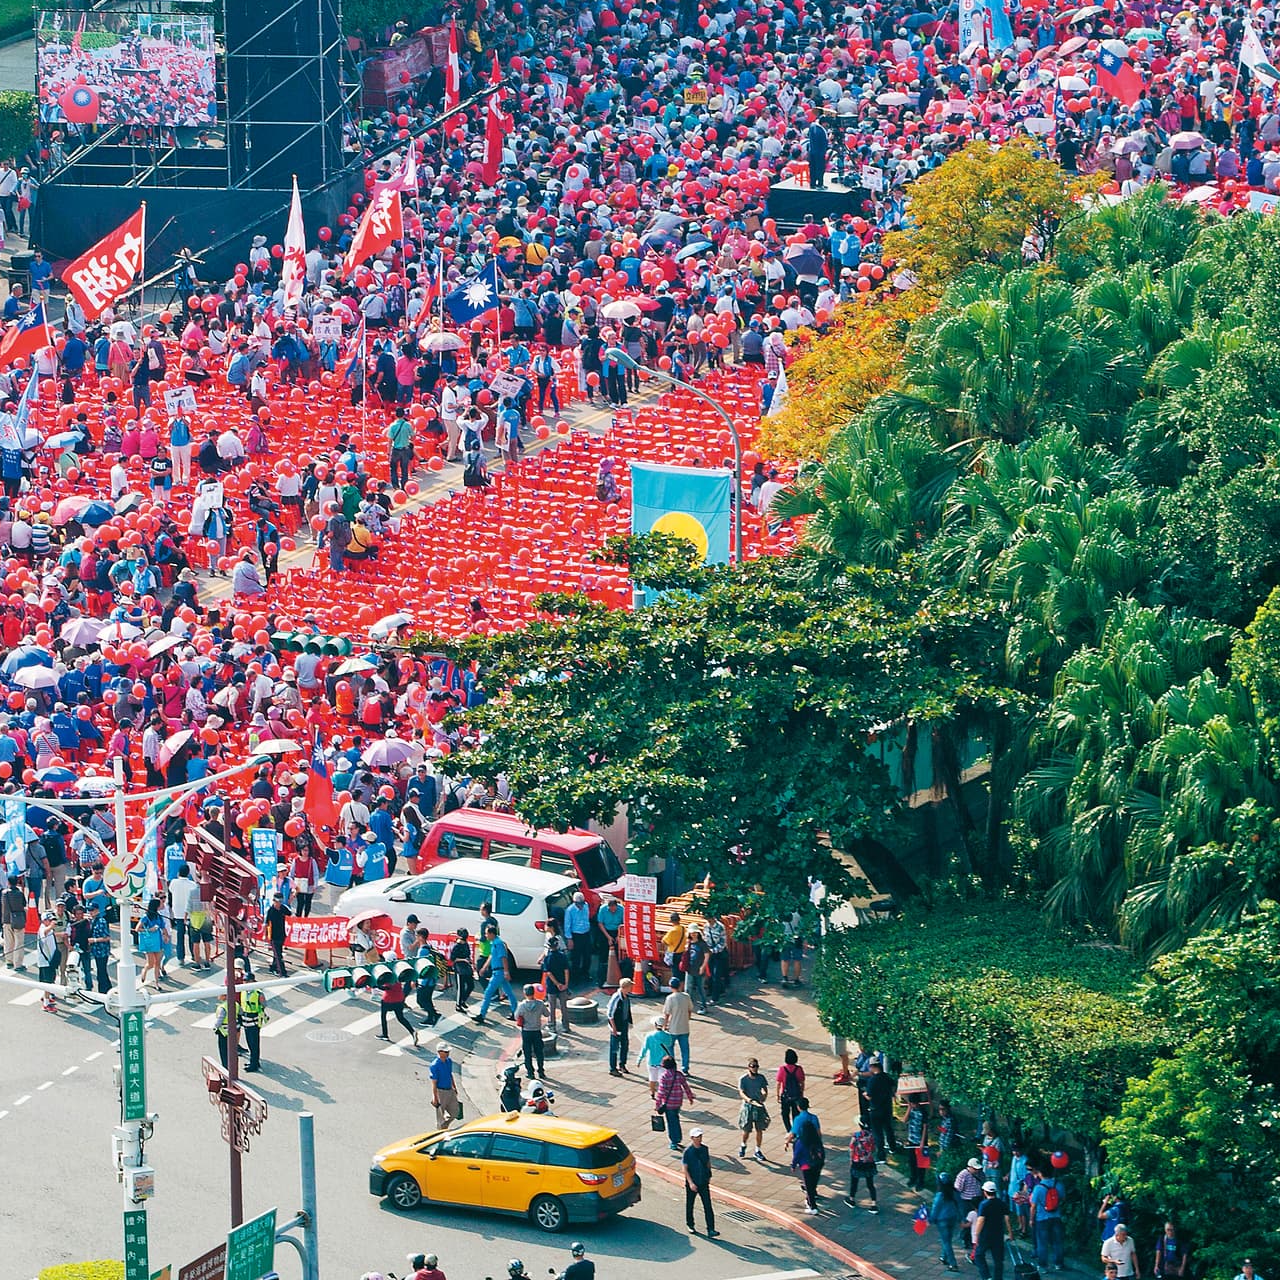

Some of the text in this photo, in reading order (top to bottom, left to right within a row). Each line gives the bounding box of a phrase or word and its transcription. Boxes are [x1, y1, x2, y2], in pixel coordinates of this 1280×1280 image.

[127, 1021, 141, 1104] 凱達格蘭大道
